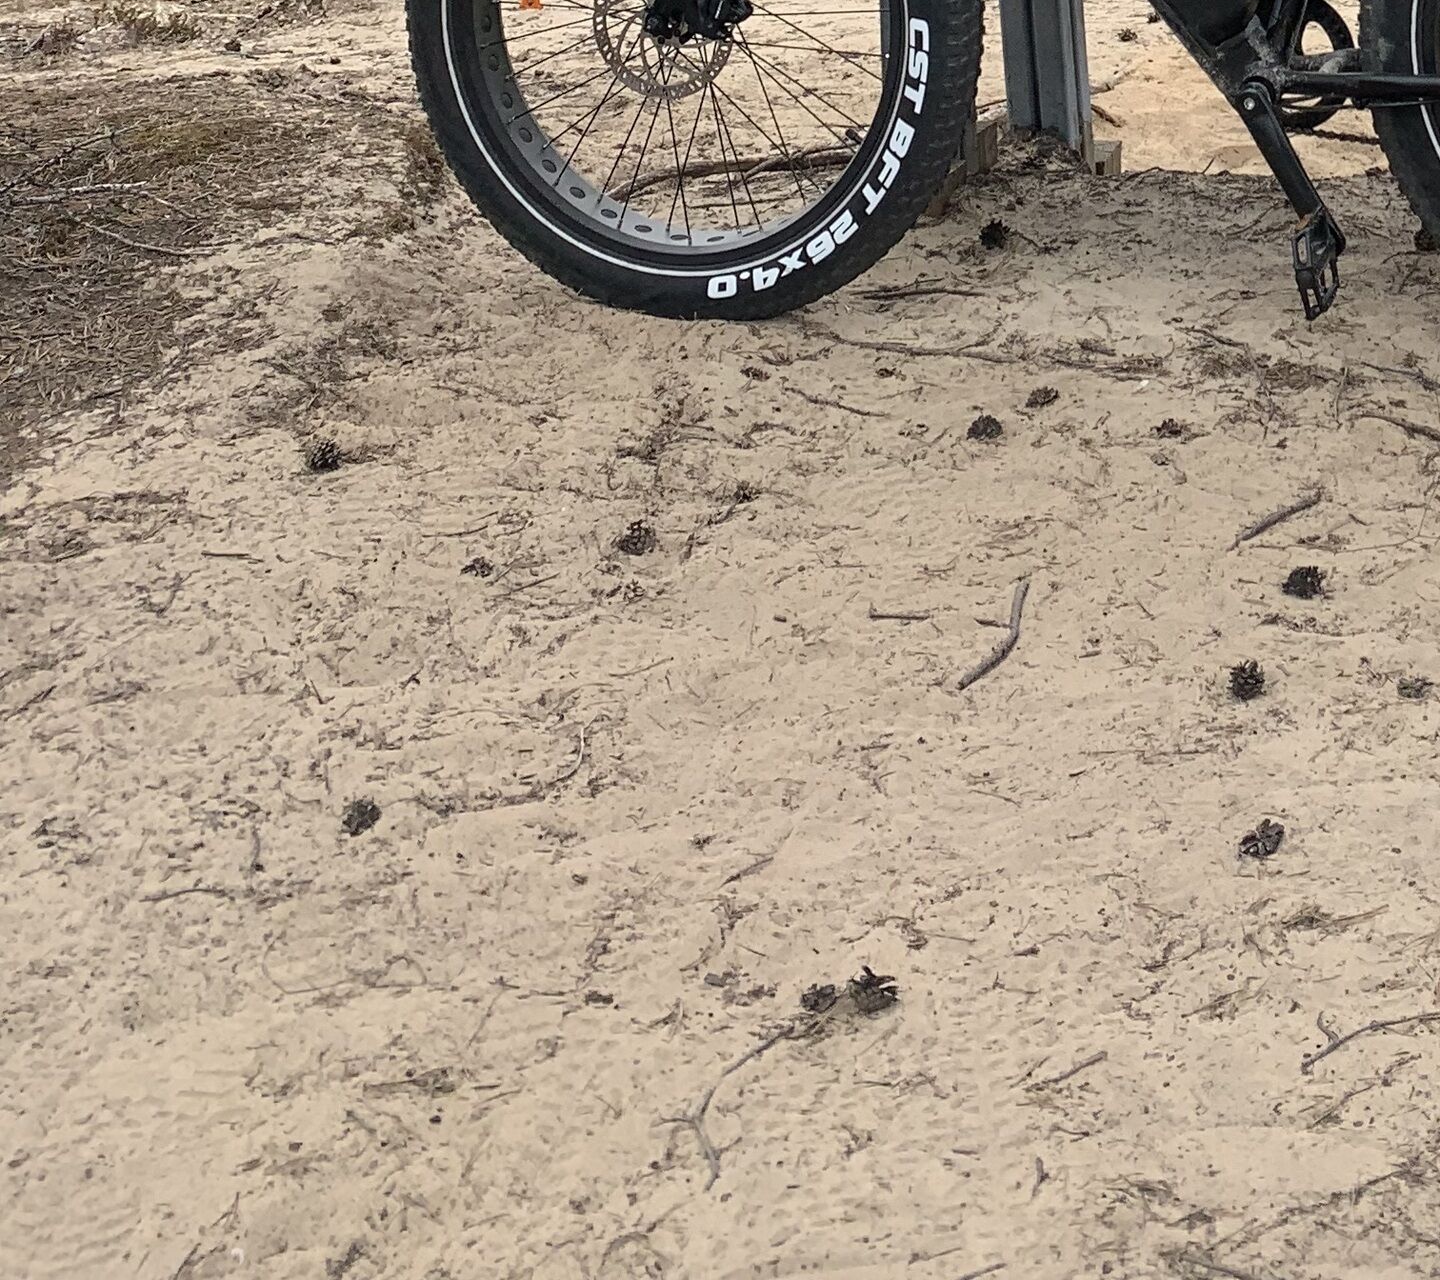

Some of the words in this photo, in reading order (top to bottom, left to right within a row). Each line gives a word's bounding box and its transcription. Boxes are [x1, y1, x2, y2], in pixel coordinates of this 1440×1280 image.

[903, 17, 930, 115] CST
[861, 117, 916, 216] BFT
[706, 208, 860, 300] 26x4.0
